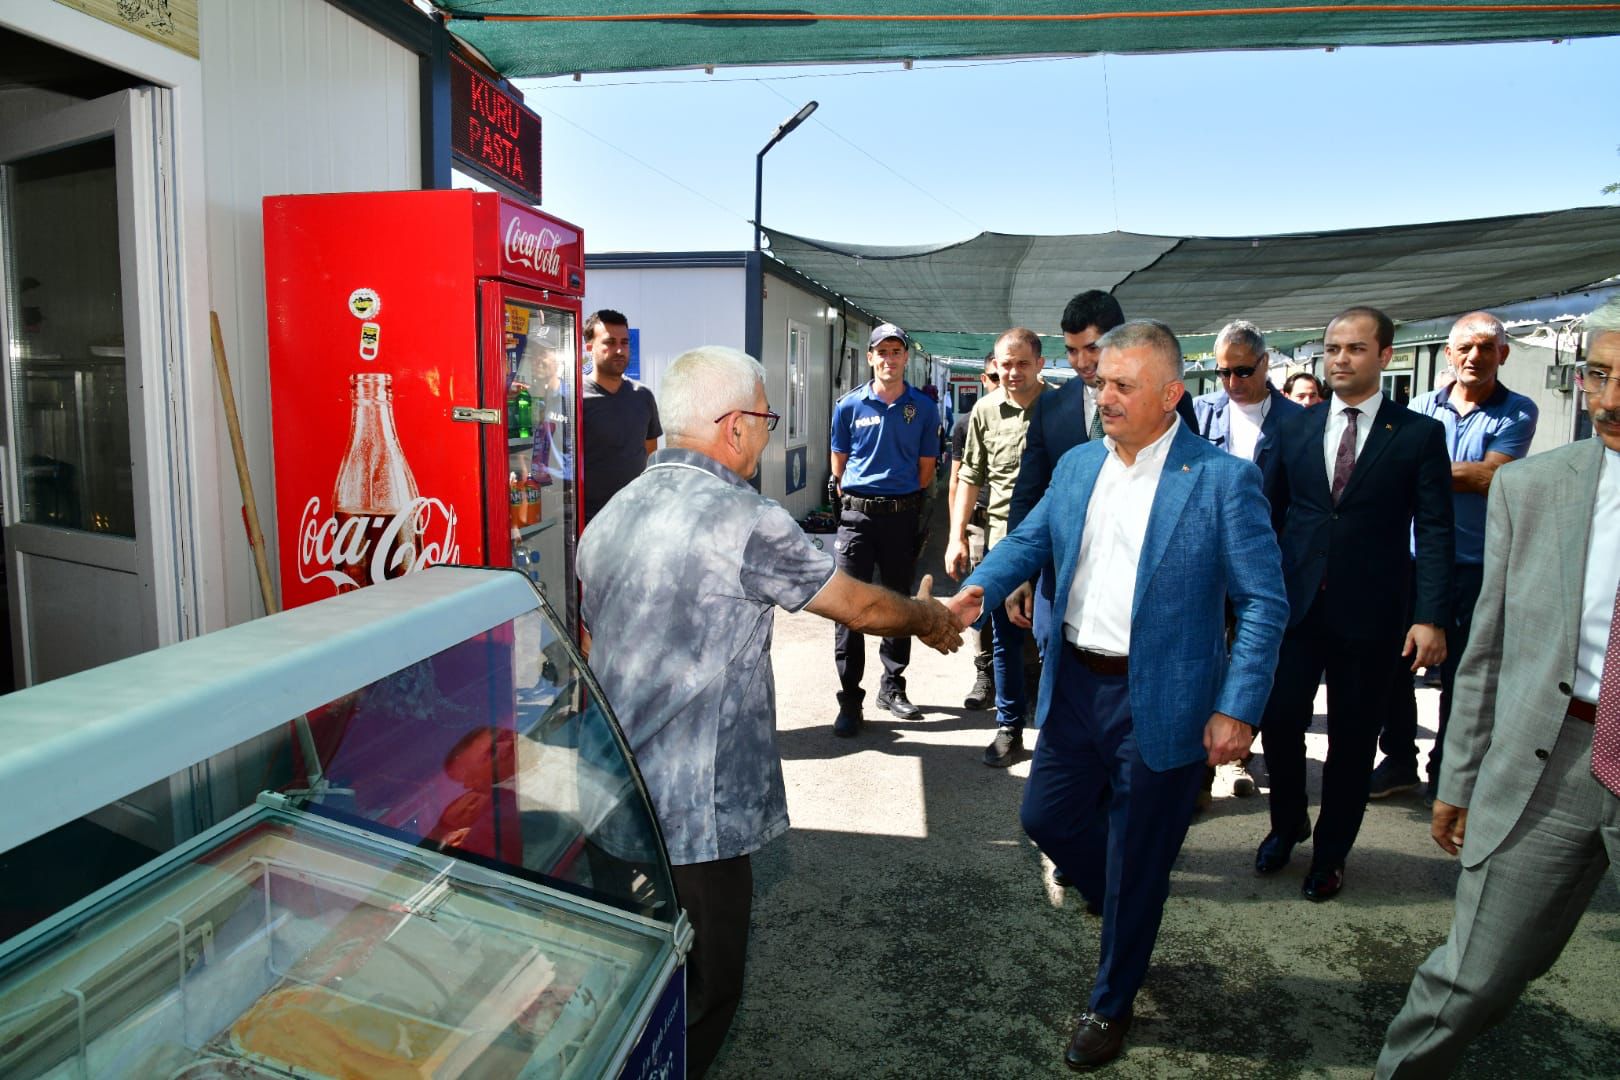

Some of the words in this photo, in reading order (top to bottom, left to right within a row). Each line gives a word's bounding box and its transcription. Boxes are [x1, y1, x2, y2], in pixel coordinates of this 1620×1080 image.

[471, 75, 521, 139] KURU
[468, 115, 525, 181] PASTA
[505, 216, 562, 276] Coca-Cola
